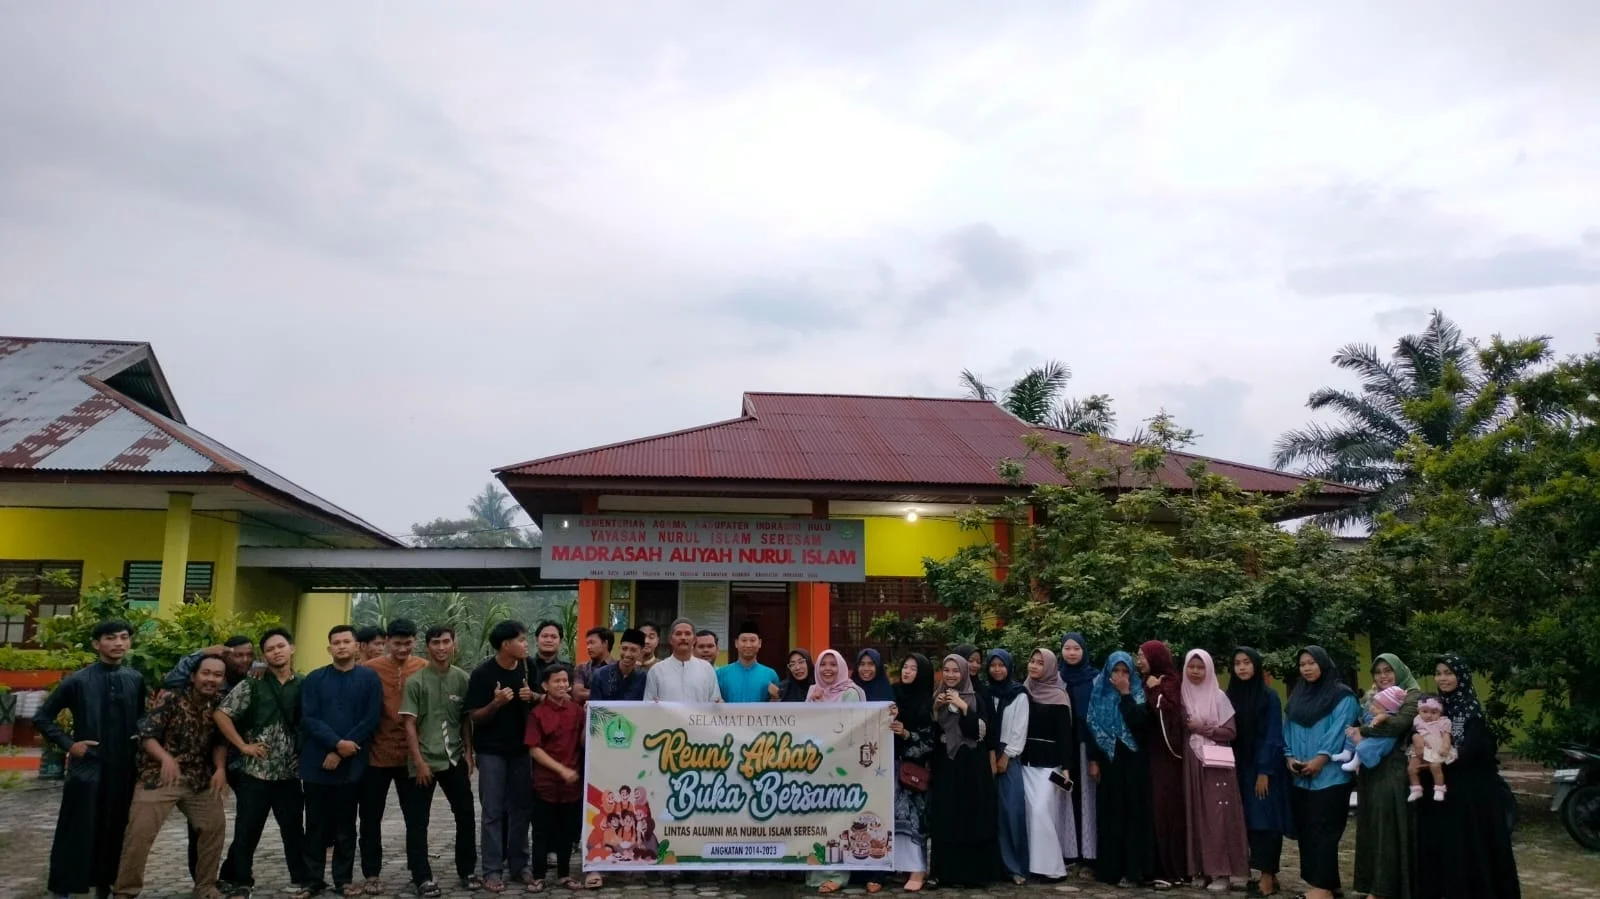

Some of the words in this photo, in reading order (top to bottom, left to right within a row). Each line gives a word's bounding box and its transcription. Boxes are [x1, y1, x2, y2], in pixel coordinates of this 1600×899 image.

[591, 530, 646, 542] YAYASAN
[658, 531, 700, 543] NURUL
[711, 532, 752, 544] ISLAM
[761, 533, 822, 546] SERESAM
[552, 545, 662, 562] MADRASAH
[669, 547, 732, 563] ALIYAH
[739, 548, 796, 564] NURUL
[802, 548, 856, 565] ISLAM
[688, 714, 746, 727] SELAMAT
[746, 714, 796, 728] DATANG
[644, 729, 734, 774] Reuni
[739, 732, 822, 778] Akbar
[668, 770, 746, 819] Buka
[751, 771, 867, 820] Bersama
[664, 826, 690, 836] LINTAS
[692, 826, 724, 836] ALUMNI
[725, 826, 738, 836] MA
[740, 826, 766, 836] NURUL
[768, 826, 791, 836] ISLAM
[793, 826, 828, 836] SERESAM
[710, 846, 744, 856] ANGKATAN
[744, 846, 777, 855] 2014-2023
